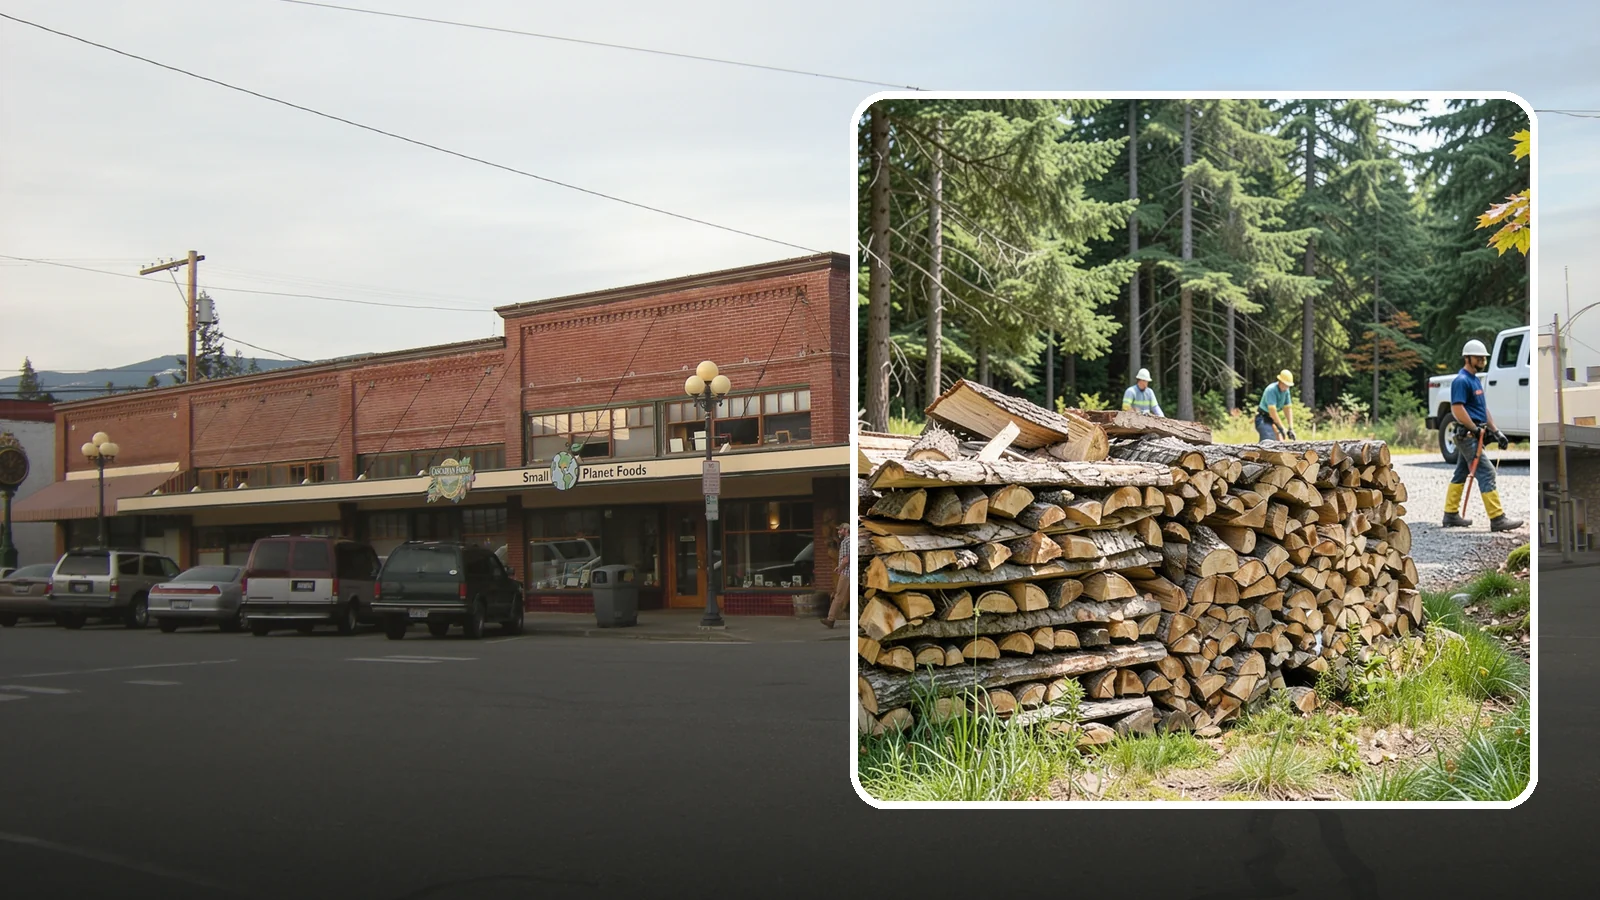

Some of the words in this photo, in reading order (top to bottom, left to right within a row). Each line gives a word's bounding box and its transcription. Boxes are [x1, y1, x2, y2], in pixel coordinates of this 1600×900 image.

[523, 471, 549, 483] Small
[582, 467, 614, 479] Planet
[616, 464, 647, 477] Foods
